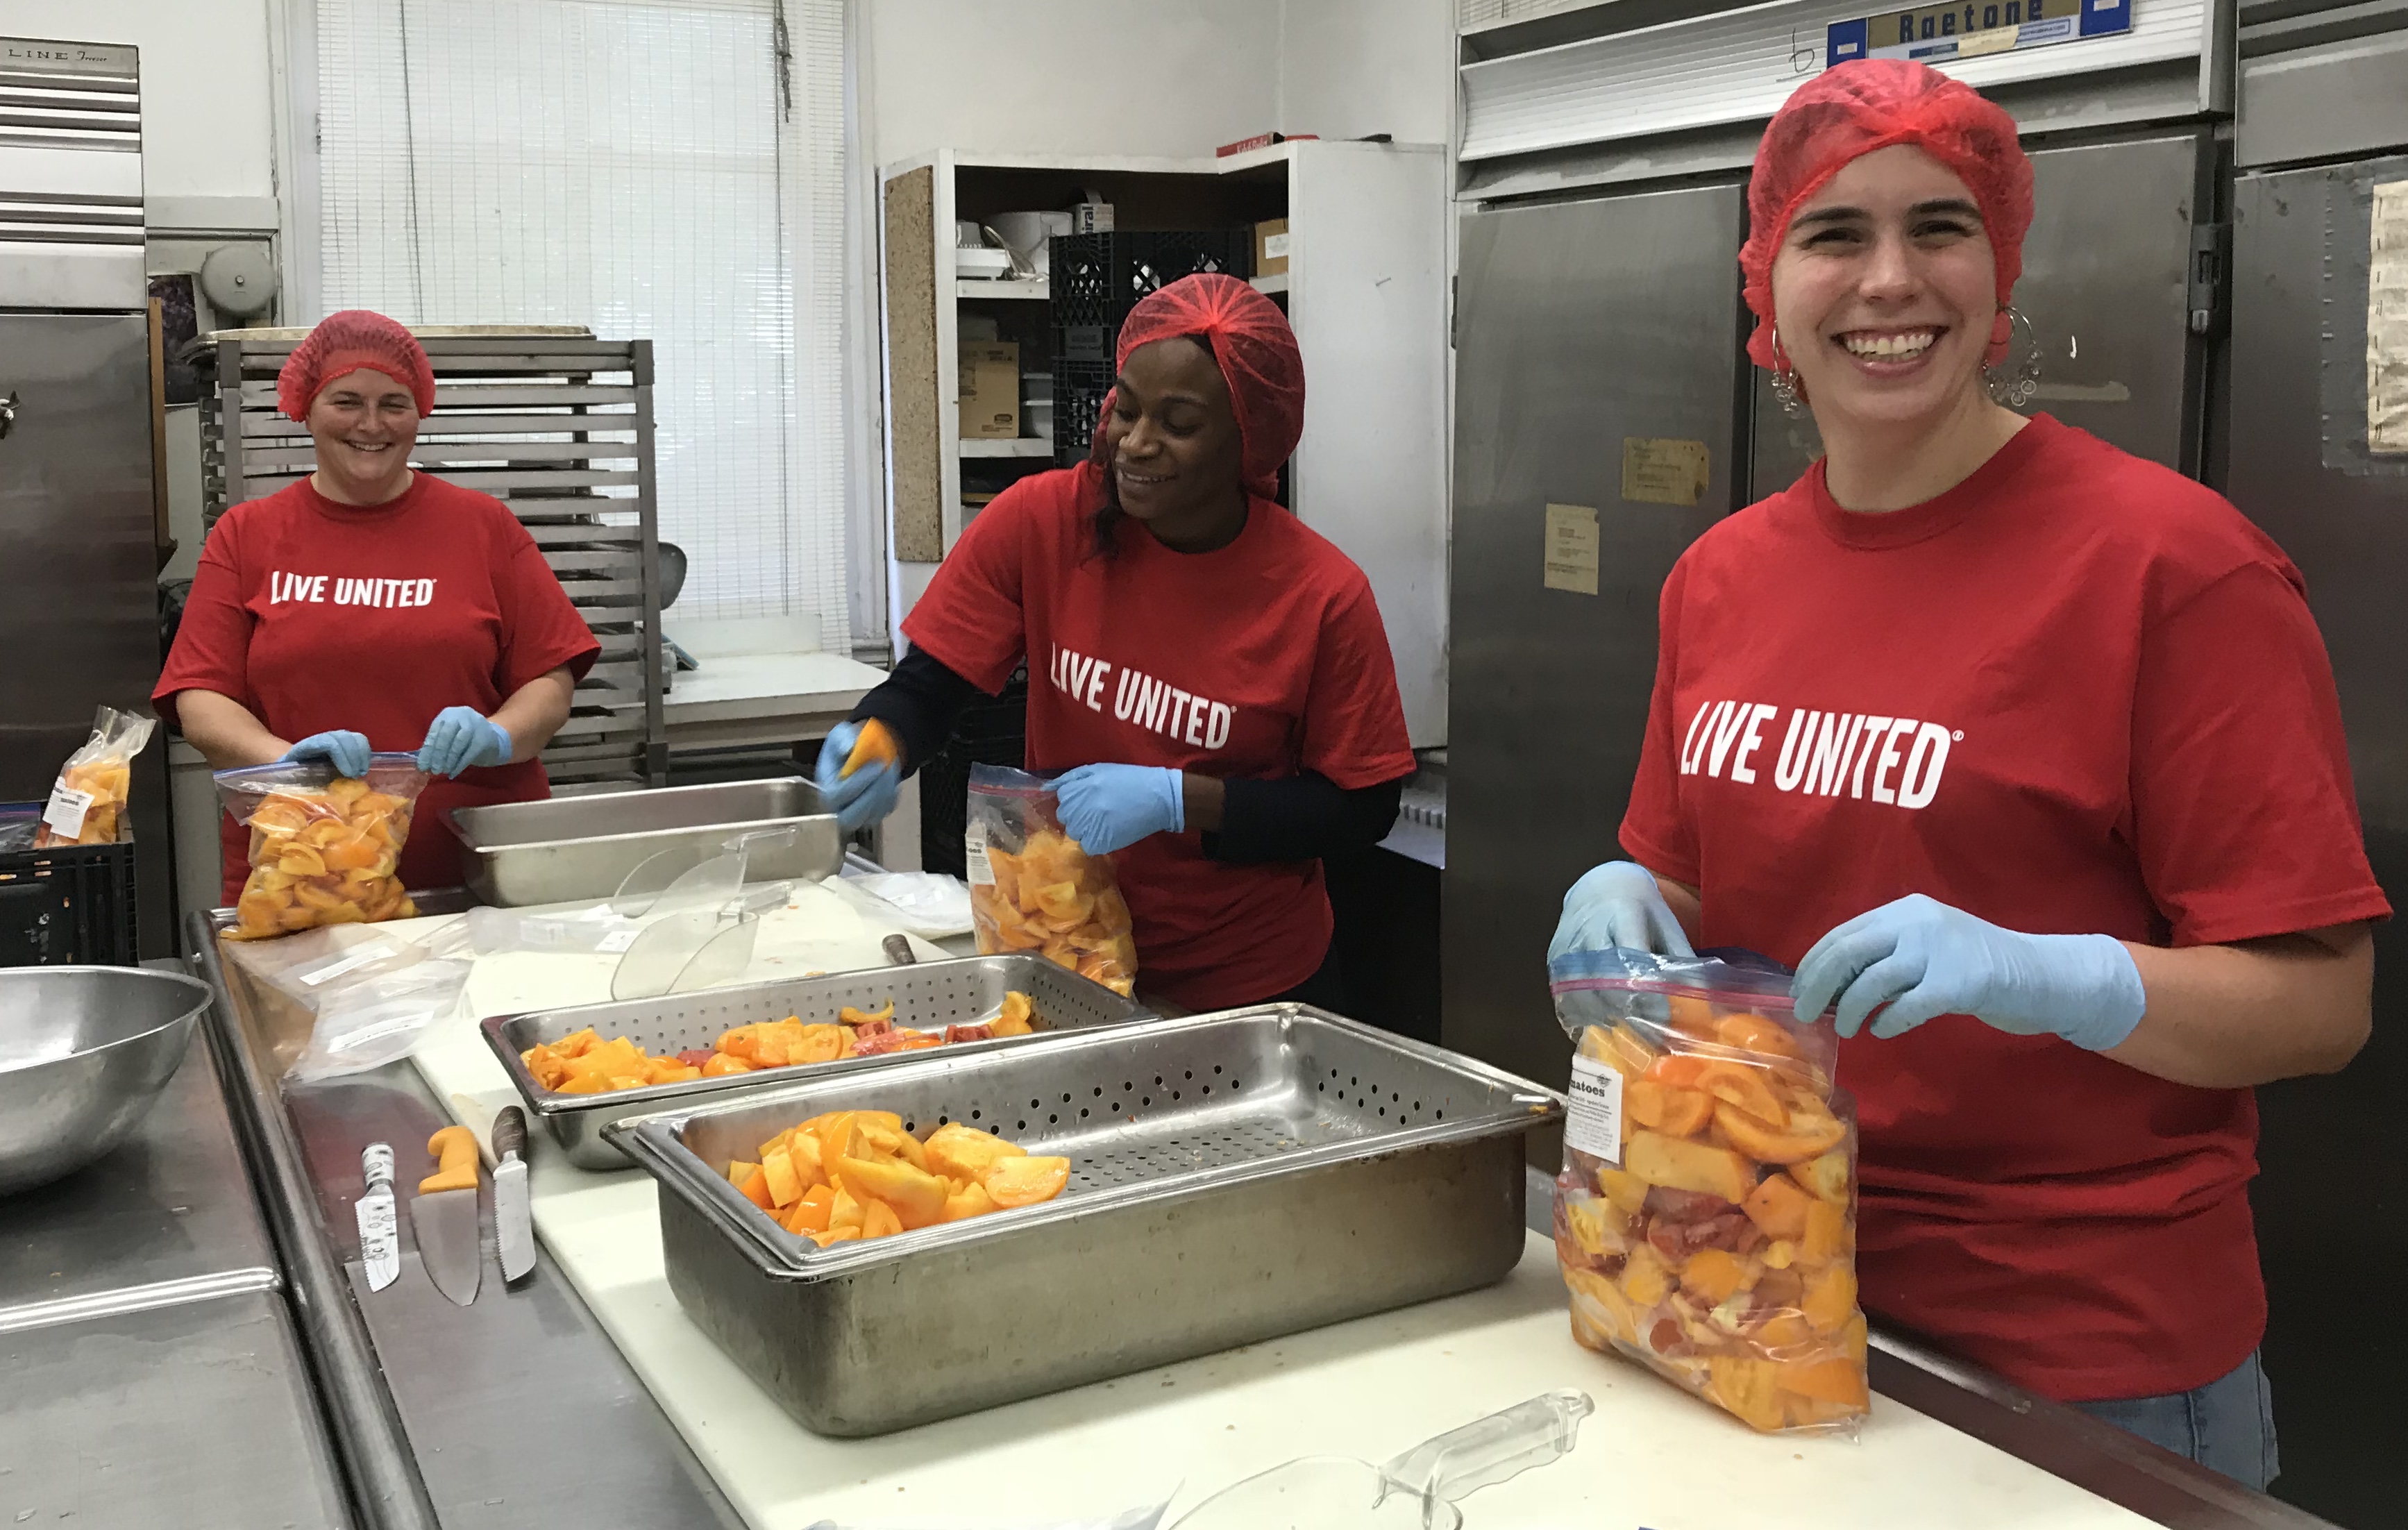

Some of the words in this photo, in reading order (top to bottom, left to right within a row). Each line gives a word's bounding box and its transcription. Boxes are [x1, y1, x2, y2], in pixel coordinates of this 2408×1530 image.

[1899, 0, 2042, 43] Raetone
[8, 49, 68, 60] LINE
[270, 571, 329, 605] LIVE
[1050, 640, 1111, 713] LIVE
[1680, 700, 1778, 784] LIVE
